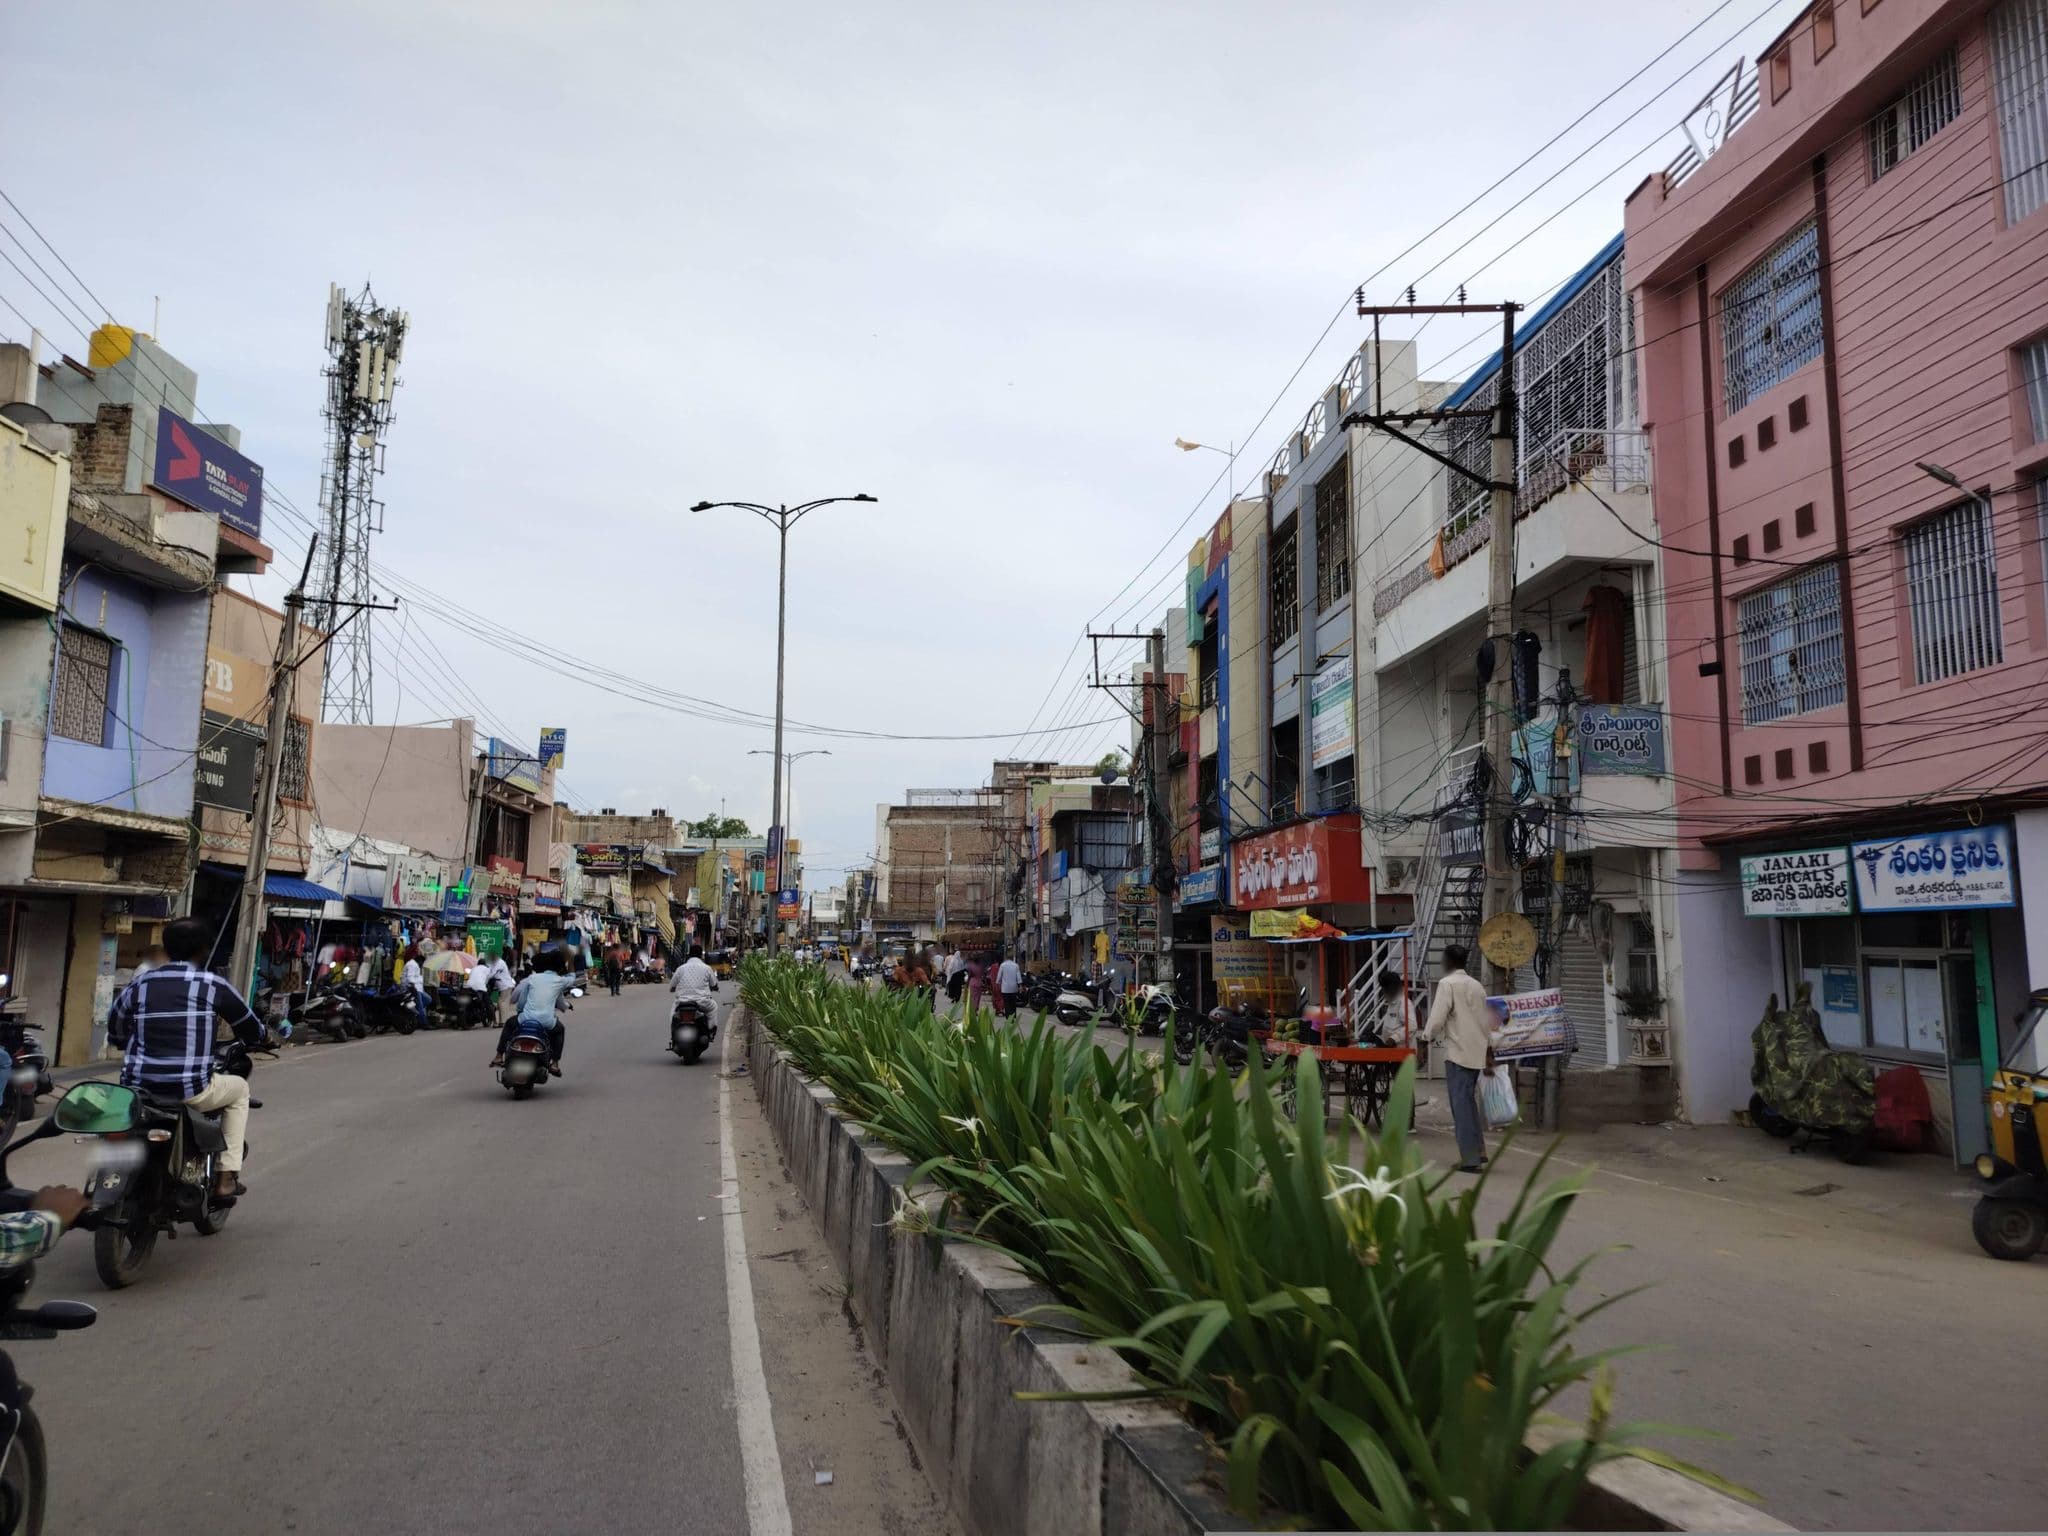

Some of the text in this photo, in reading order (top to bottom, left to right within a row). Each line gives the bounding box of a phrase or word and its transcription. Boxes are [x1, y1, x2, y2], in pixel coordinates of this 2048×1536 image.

[205, 460, 227, 482] TATA
[1580, 711, 1660, 735] శ్రీ సాయిరాం
[1594, 732, 1651, 758] గార్మెంట్స్
[1762, 853, 1830, 871] JANAKI
[1758, 868, 1835, 885] MEDICALS
[1751, 884, 1797, 902] జానకి
[1511, 1011, 1538, 1020] PUBLIC
